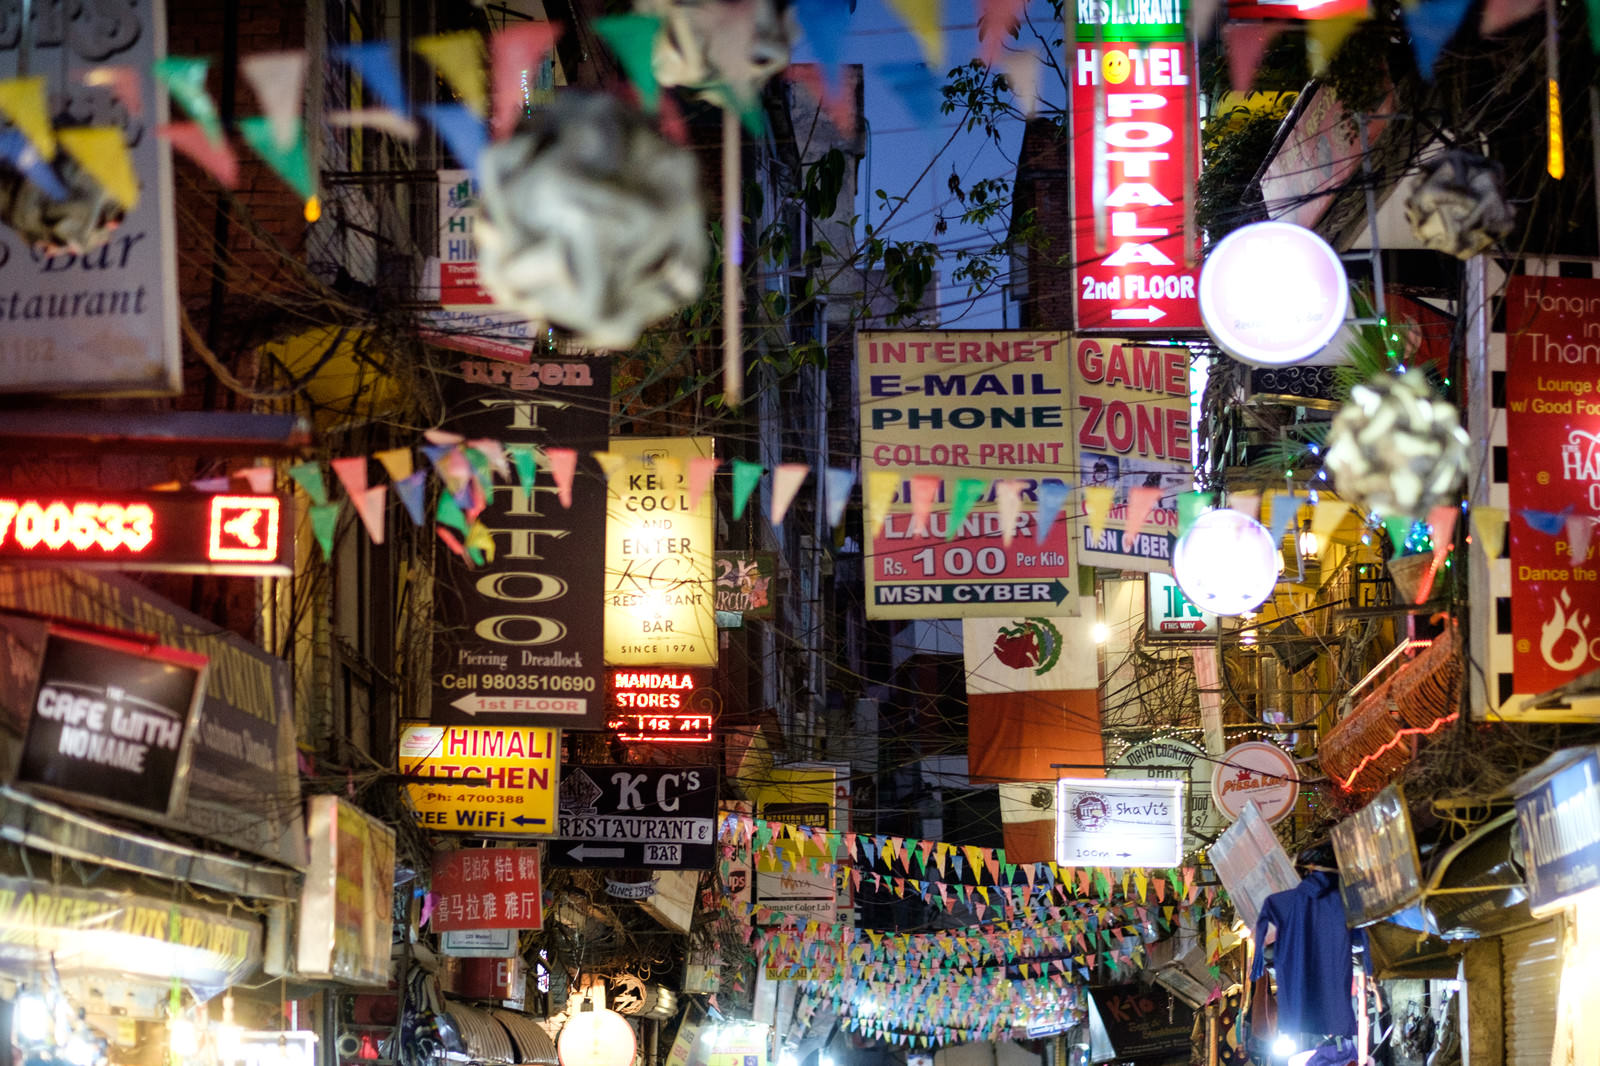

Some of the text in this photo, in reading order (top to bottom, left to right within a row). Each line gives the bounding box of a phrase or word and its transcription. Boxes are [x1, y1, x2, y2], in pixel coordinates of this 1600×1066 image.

[1082, 274, 1196, 300] 2nd FLOOR
[868, 340, 1059, 364] INTERNET
[1076, 339, 1187, 397] GAME
[869, 373, 1062, 397] E-MAIL
[1537, 376, 1592, 395] Lounge
[1532, 398, 1573, 414] Good
[871, 406, 1064, 430] PHONE
[1078, 395, 1192, 462] ZONE
[873, 442, 1064, 466] COLOR PRINT
[625, 495, 690, 512] COOL
[622, 538, 692, 554] ENTER
[912, 546, 1007, 577] 100
[1016, 551, 1036, 567] Per
[1040, 551, 1065, 567] Kilo
[1518, 566, 1598, 581] Dance the
[879, 584, 1052, 604] MSN CYBER
[642, 620, 674, 633] BAR
[620, 644, 696, 654] SINCE 1976
[458, 650, 584, 671] Piercing Dreadlock
[442, 674, 596, 692] Cell 9803510690
[615, 673, 694, 690] MANDALA
[37, 688, 108, 732] CAFE
[477, 699, 580, 712] 1st FLOOR
[616, 692, 681, 709] STORES
[449, 729, 554, 759] HIMALI
[402, 764, 550, 790] KITCHEN
[427, 793, 452, 803] Ph:
[456, 809, 506, 828] WiFi
[560, 817, 697, 841] RESTAURANT
[649, 846, 679, 862] BAR
